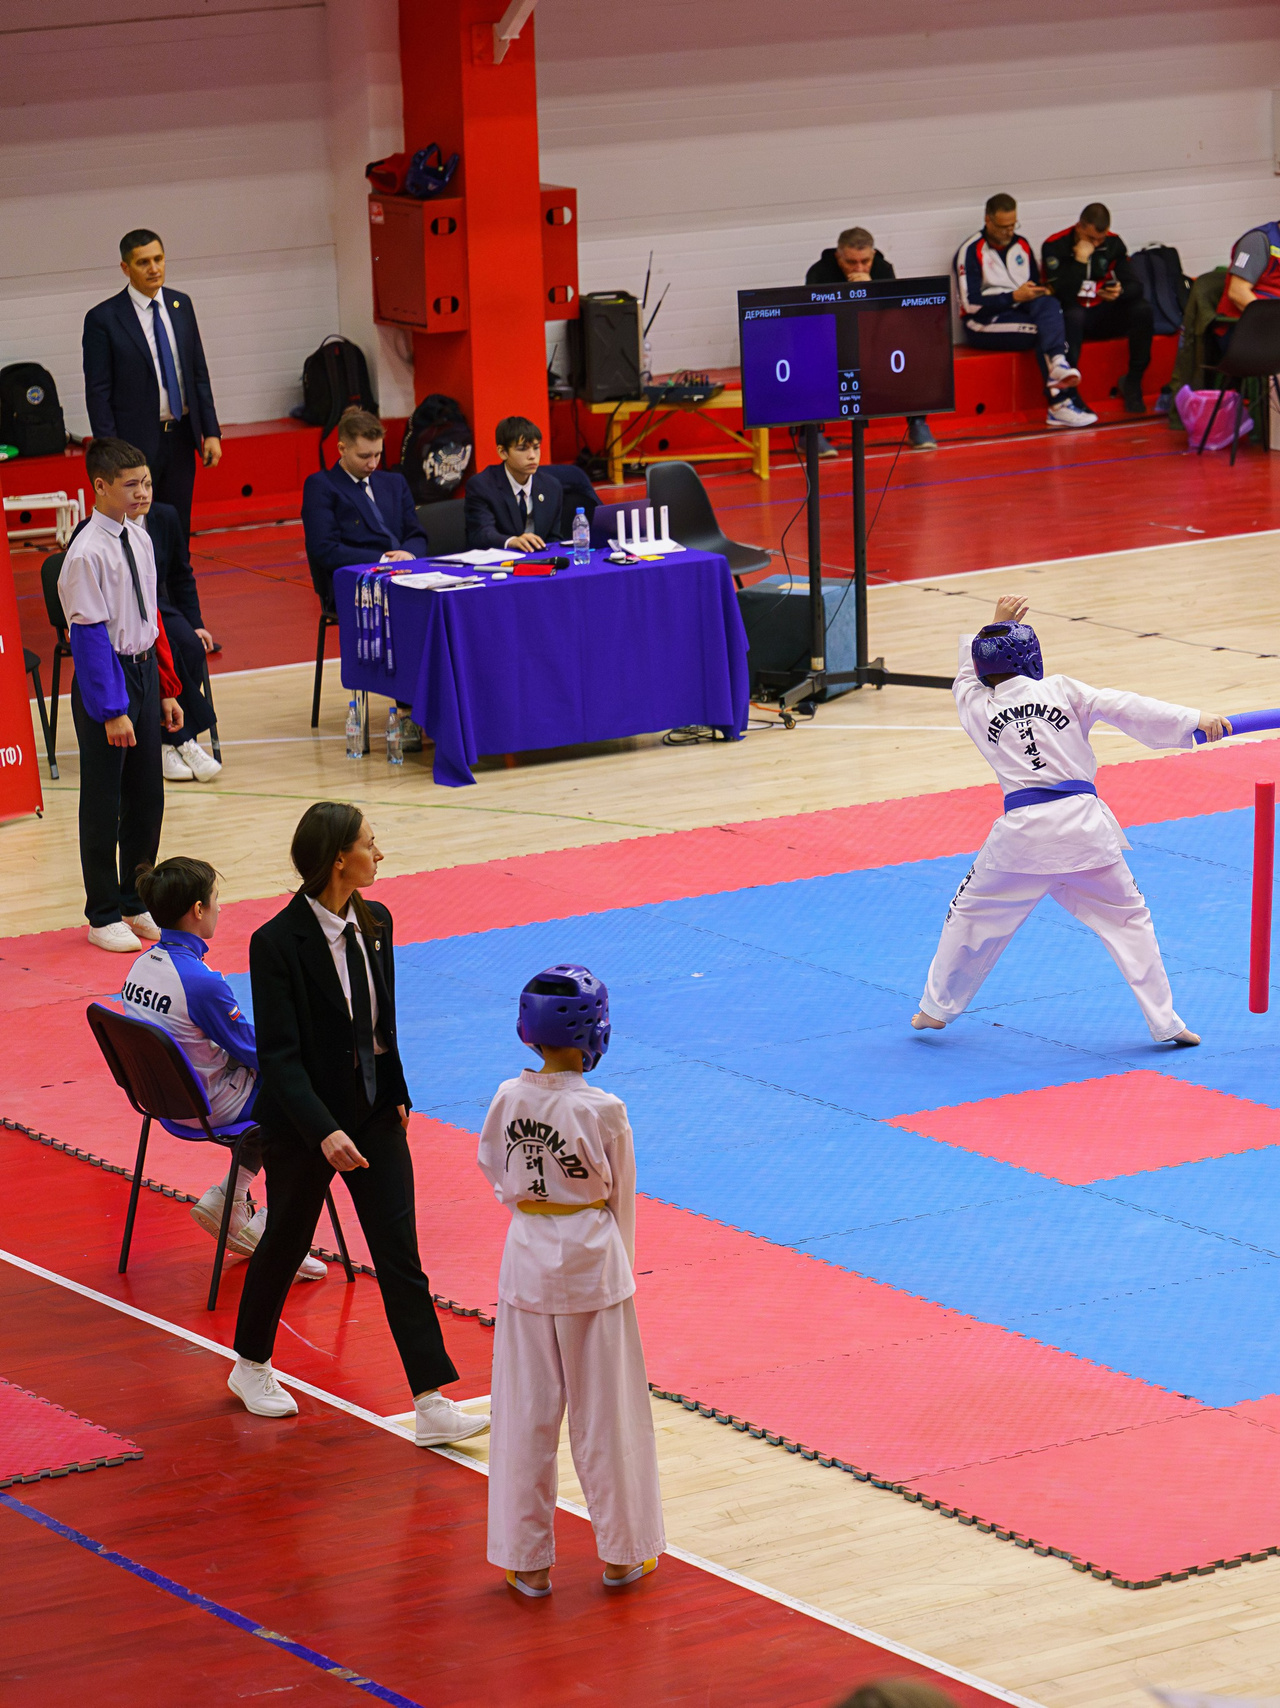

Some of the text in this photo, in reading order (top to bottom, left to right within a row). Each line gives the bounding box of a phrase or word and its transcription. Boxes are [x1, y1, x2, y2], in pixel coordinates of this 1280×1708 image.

[811, 289, 868, 302] Раунд 1 0:03
[901, 296, 947, 307] АРМБИСТЕР
[744, 308, 781, 320] ДЕРЯБИН
[890, 350, 906, 374] 0
[775, 359, 791, 383] 0
[840, 380, 859, 392] 0 0
[841, 403, 860, 415] 0 0
[987, 703, 1071, 745] TAEKWON-DO
[1015, 719, 1032, 729] ITF
[0, 744, 23, 767] ТФ)
[504, 1118, 589, 1180] KWON-DO
[522, 1143, 544, 1154] ITF
[525, 1156, 550, 1202] 태권
